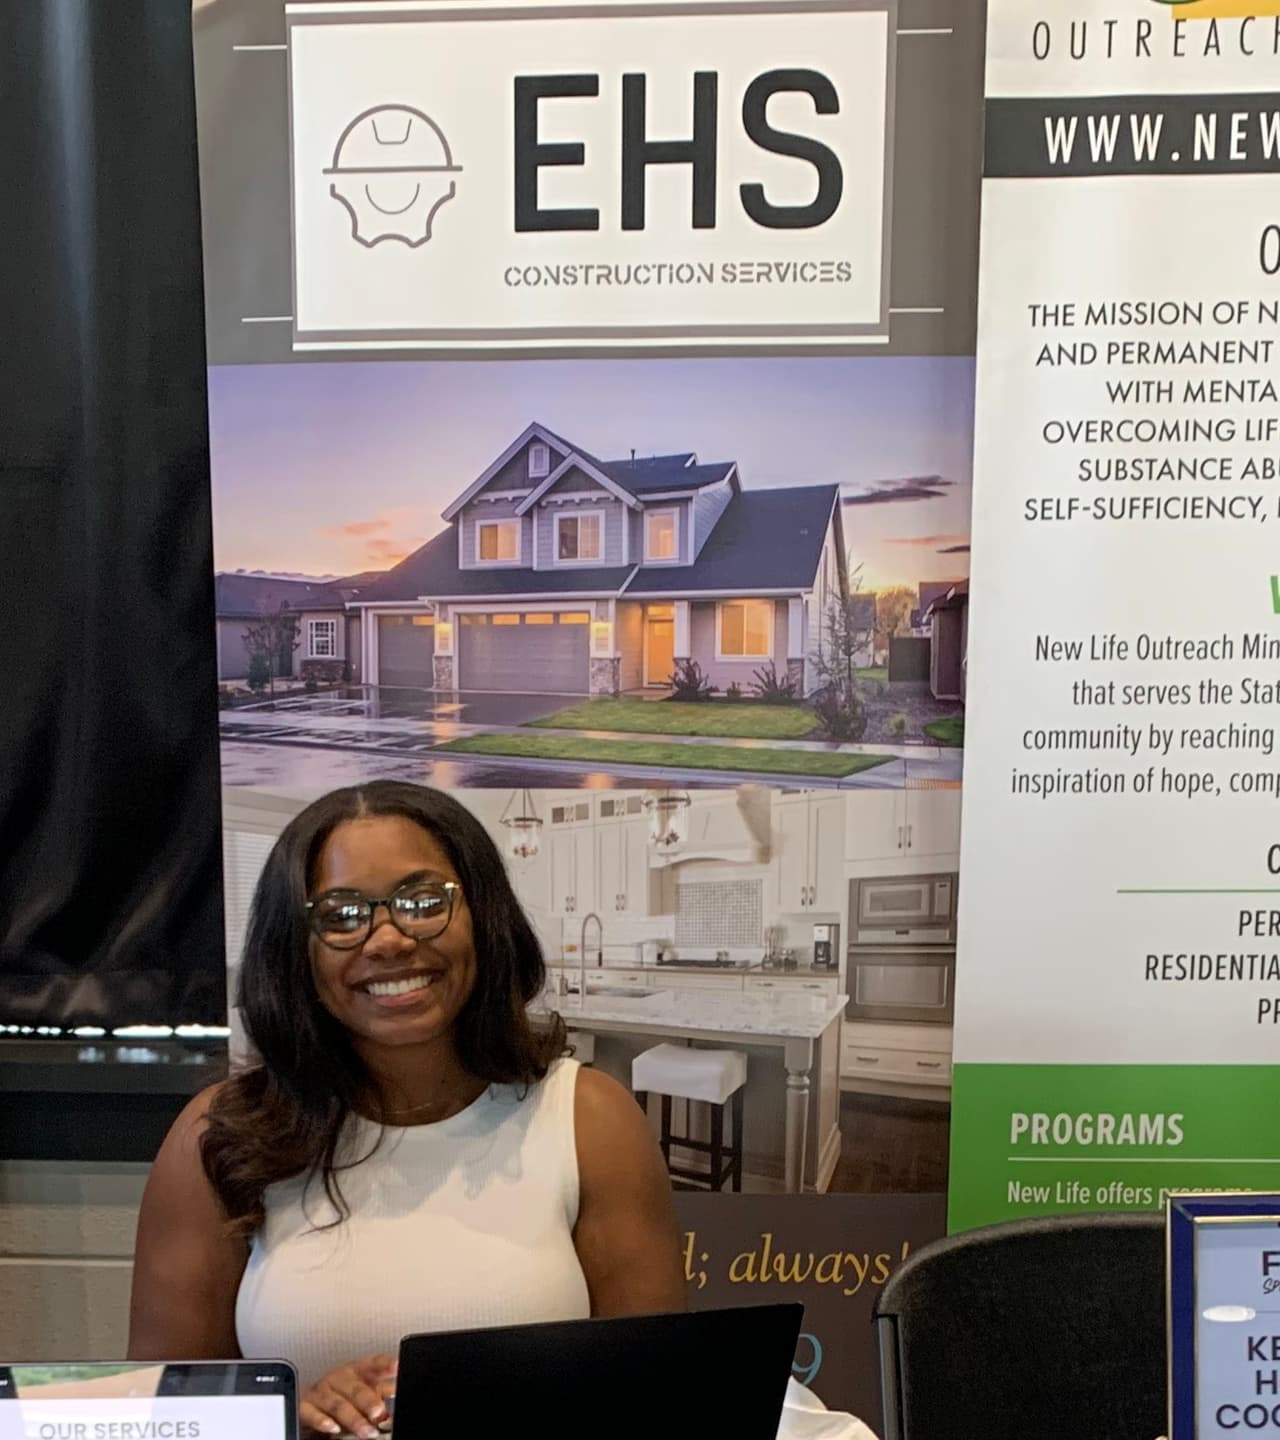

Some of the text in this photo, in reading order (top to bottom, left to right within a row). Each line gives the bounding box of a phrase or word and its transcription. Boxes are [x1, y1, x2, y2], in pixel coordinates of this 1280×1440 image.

[514, 68, 844, 233] EHS
[504, 261, 852, 287] CONSTRUCTION SERVICES
[1028, 304, 1075, 327] THE
[1085, 302, 1202, 326] MISSION
[1212, 301, 1249, 325] OF
[1025, 496, 1267, 523] SELF-SUFFICIENCY,
[1011, 1113, 1183, 1145] PROGRAMS
[1008, 1181, 1050, 1203] New
[1056, 1181, 1090, 1204] Life
[1096, 1181, 1152, 1204] offers
[40, 1421, 200, 1440] OUR SERVICES
